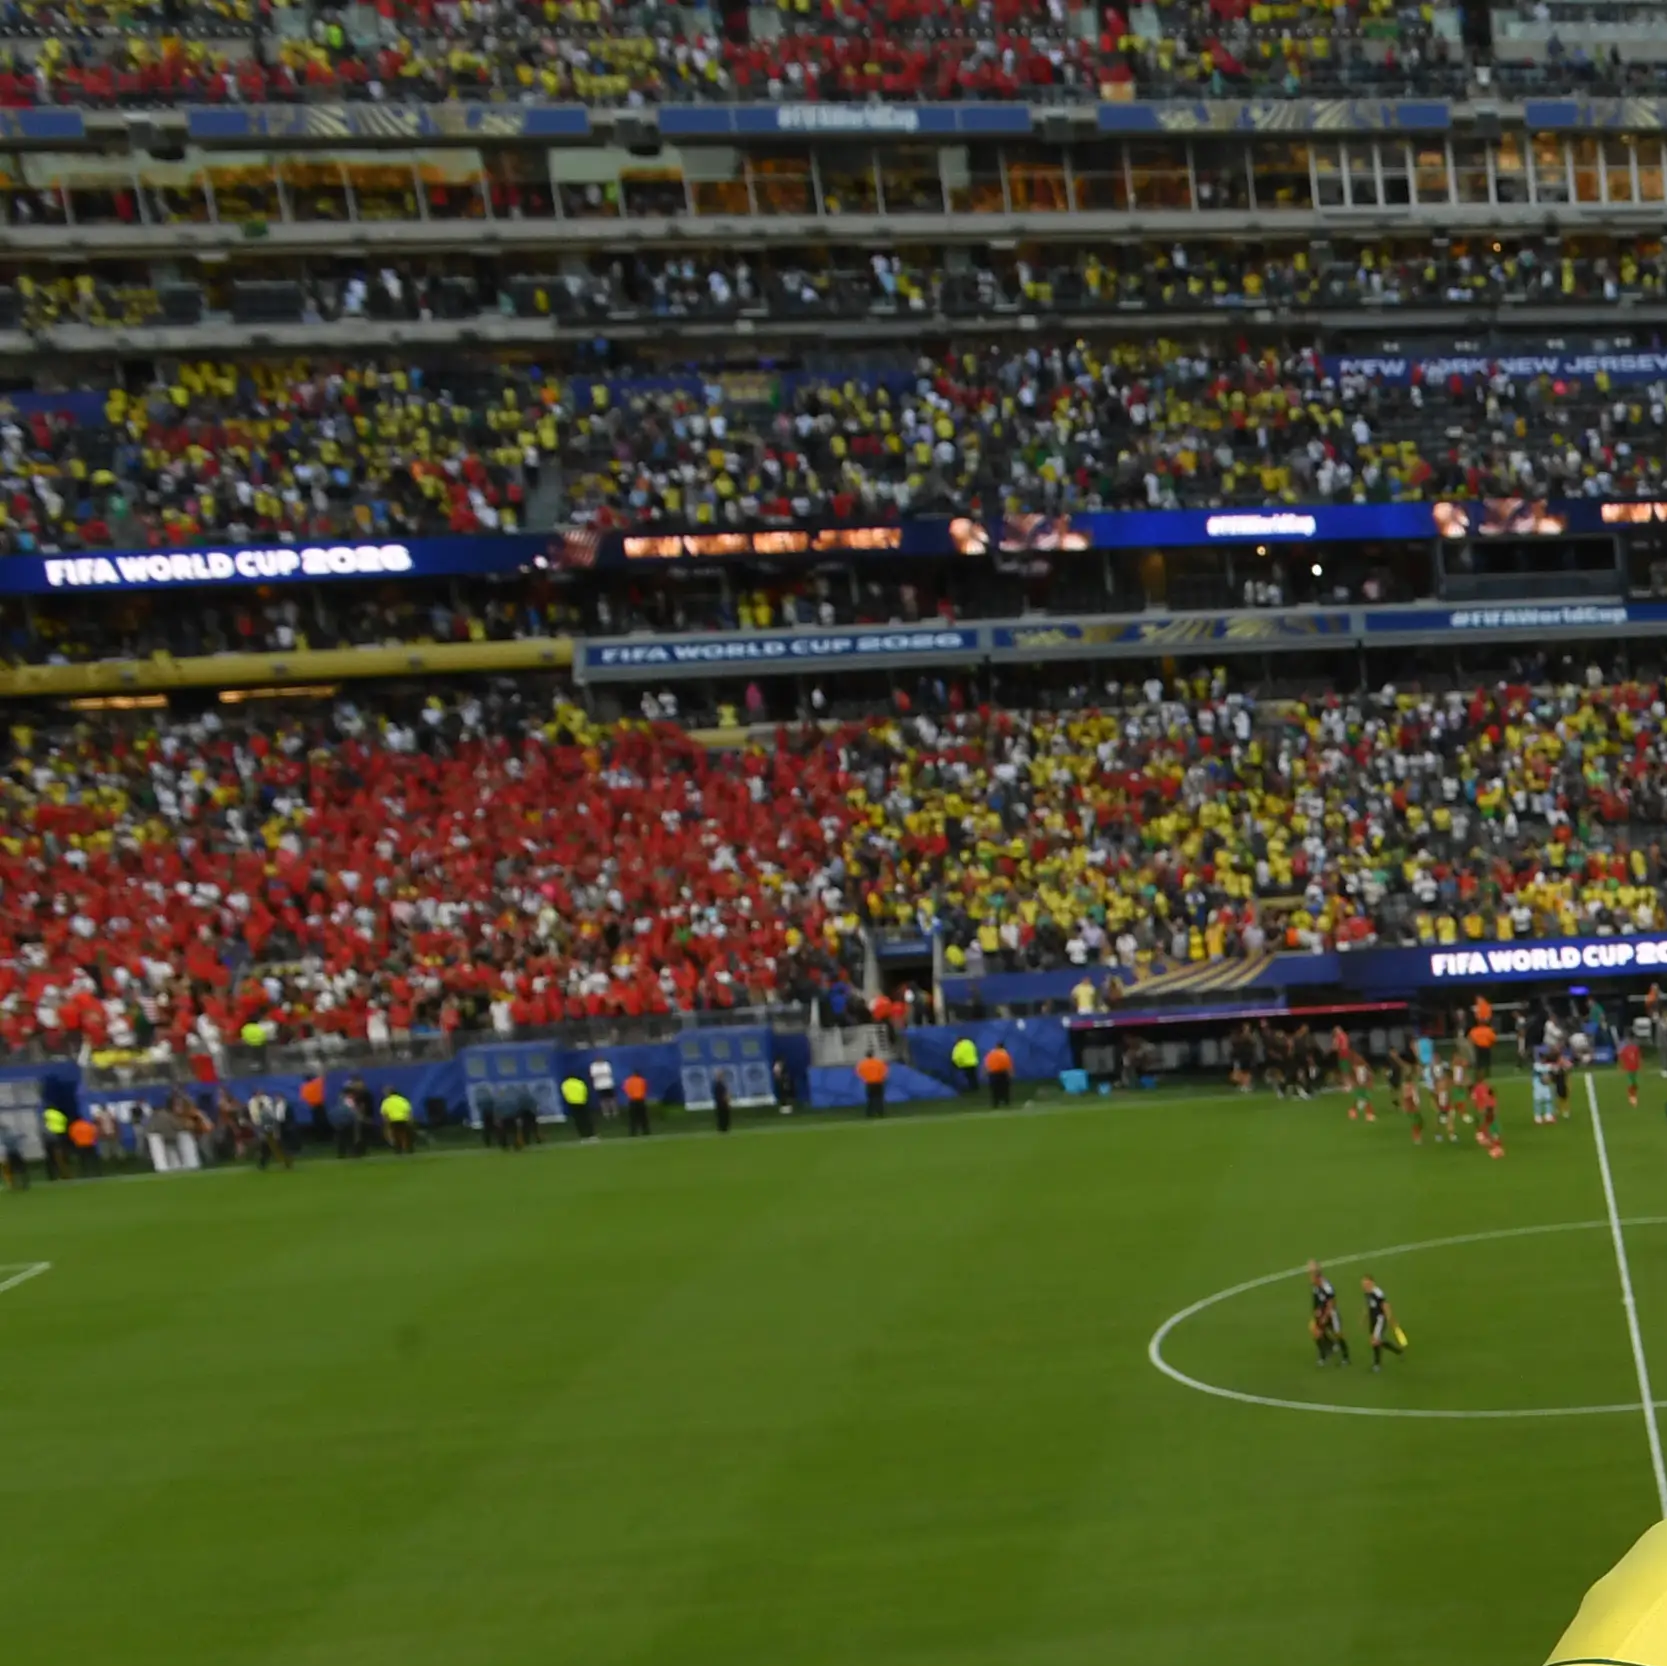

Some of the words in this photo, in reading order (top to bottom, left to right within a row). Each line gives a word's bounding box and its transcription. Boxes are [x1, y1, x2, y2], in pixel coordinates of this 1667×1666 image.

[1498, 357, 1558, 374] NEW
[44, 557, 119, 586] FIFA
[117, 552, 234, 582] WORLD
[235, 549, 300, 577] CUP
[301, 545, 412, 575] 2026
[602, 646, 669, 664] FIFA
[674, 641, 785, 660] WORLD
[790, 637, 852, 656] CUP
[857, 632, 963, 650] 2026
[1431, 952, 1489, 976] FIFA
[1488, 946, 1580, 973] WORLD
[1582, 944, 1634, 968] CUP
